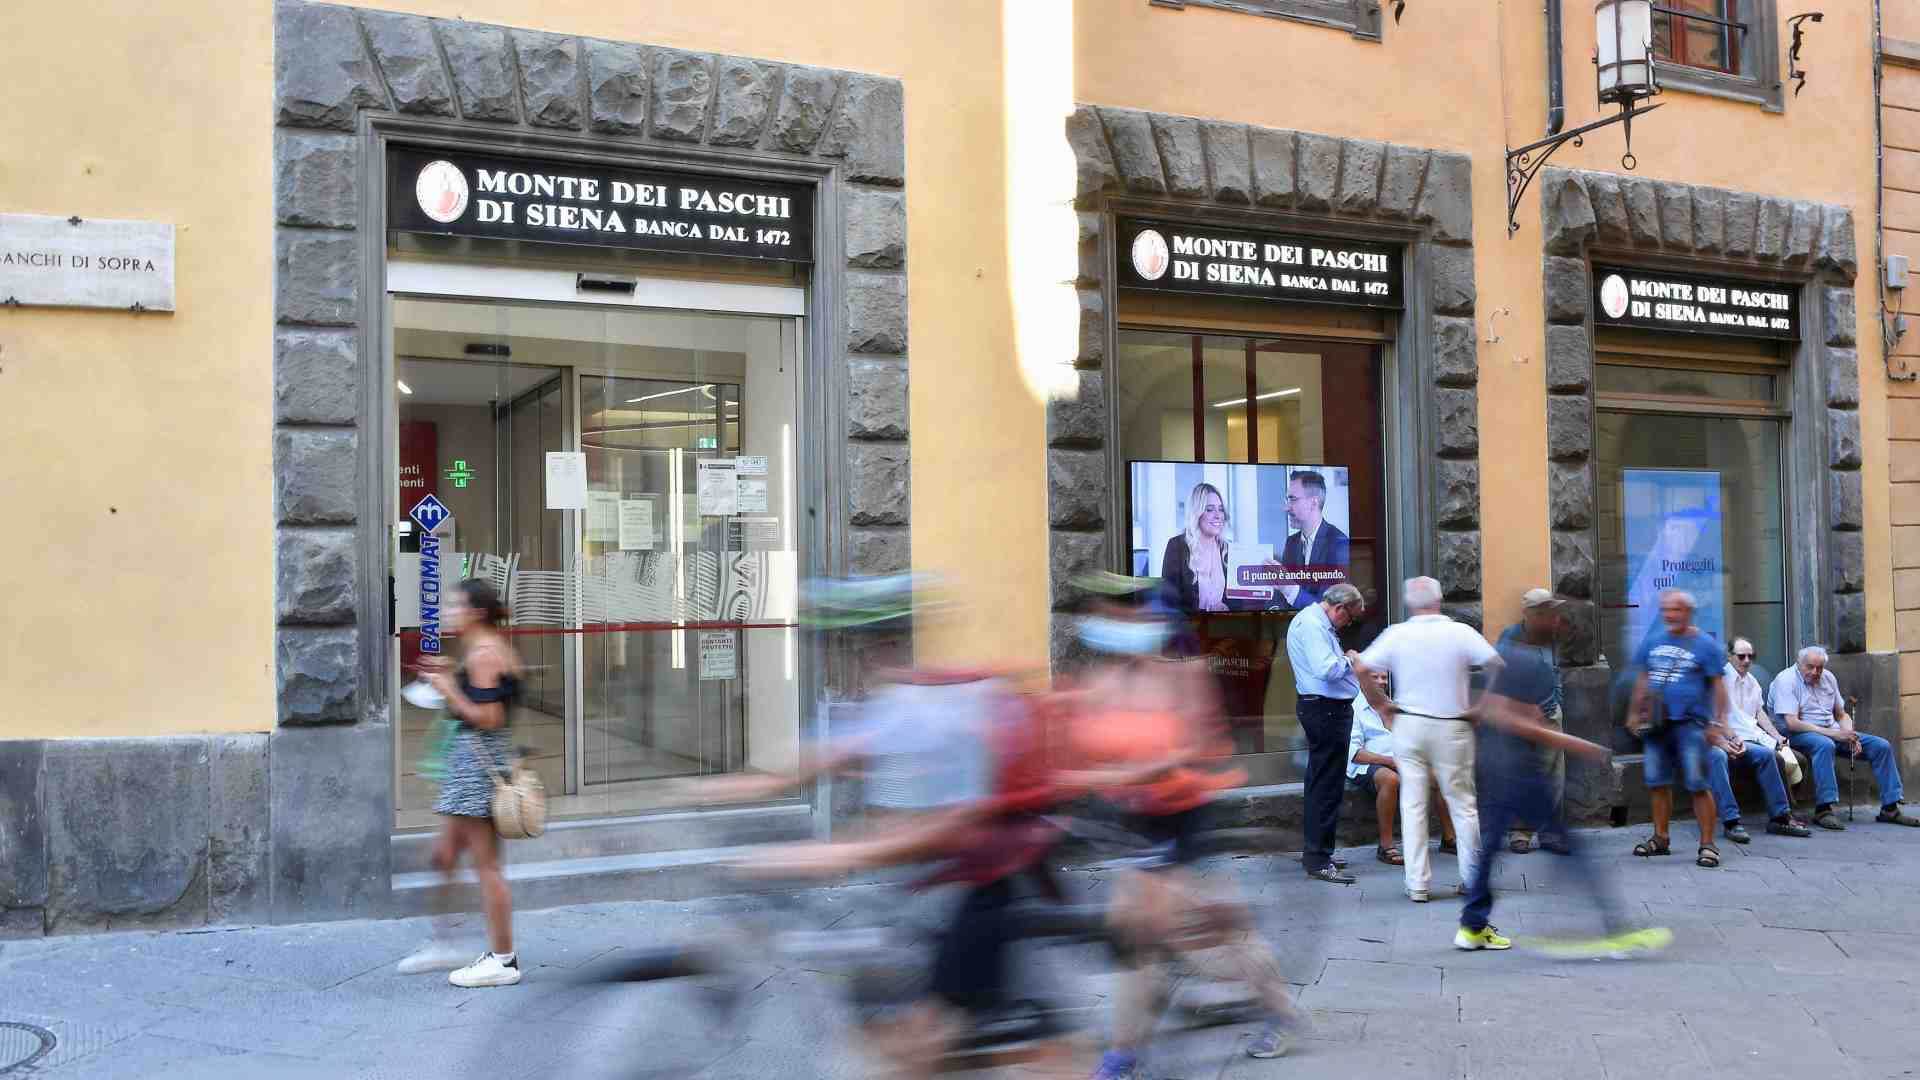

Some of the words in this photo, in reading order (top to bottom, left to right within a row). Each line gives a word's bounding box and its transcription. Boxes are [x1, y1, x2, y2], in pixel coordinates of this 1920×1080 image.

[476, 169, 601, 201] MONTE
[610, 181, 668, 208] DEI
[679, 187, 792, 218] PASCHI
[476, 199, 515, 224] DI
[526, 203, 627, 233] SIENA
[635, 218, 703, 239] BANCA
[709, 224, 750, 242] DAL
[756, 229, 791, 246] 1472
[0, 252, 62, 267] ANCHI
[71, 255, 90, 269] DI
[97, 256, 155, 272] SOPRA
[1172, 235, 1258, 261] MONTE
[1263, 243, 1304, 265] DEI
[1310, 248, 1388, 273] PASCHI
[1173, 260, 1200, 280] DI
[1206, 263, 1277, 287] SIENA
[1280, 274, 1328, 290] BANCA
[1331, 278, 1361, 293] DAL
[1363, 281, 1389, 296] 1472
[1630, 279, 1693, 301] MONTE
[1697, 286, 1727, 304] DEI
[1731, 289, 1790, 311] PASCHI
[1630, 300, 1652, 318] DI
[1655, 303, 1707, 323] SIENA
[1708, 311, 1745, 327] BANCA
[1747, 315, 1769, 328] DAL
[419, 532, 441, 654] BANCOMAT
[1243, 571, 1250, 581] Il
[1251, 571, 1278, 583] punto
[1278, 570, 1285, 580] è
[1285, 570, 1311, 581] anche
[1312, 570, 1346, 582] quando.
